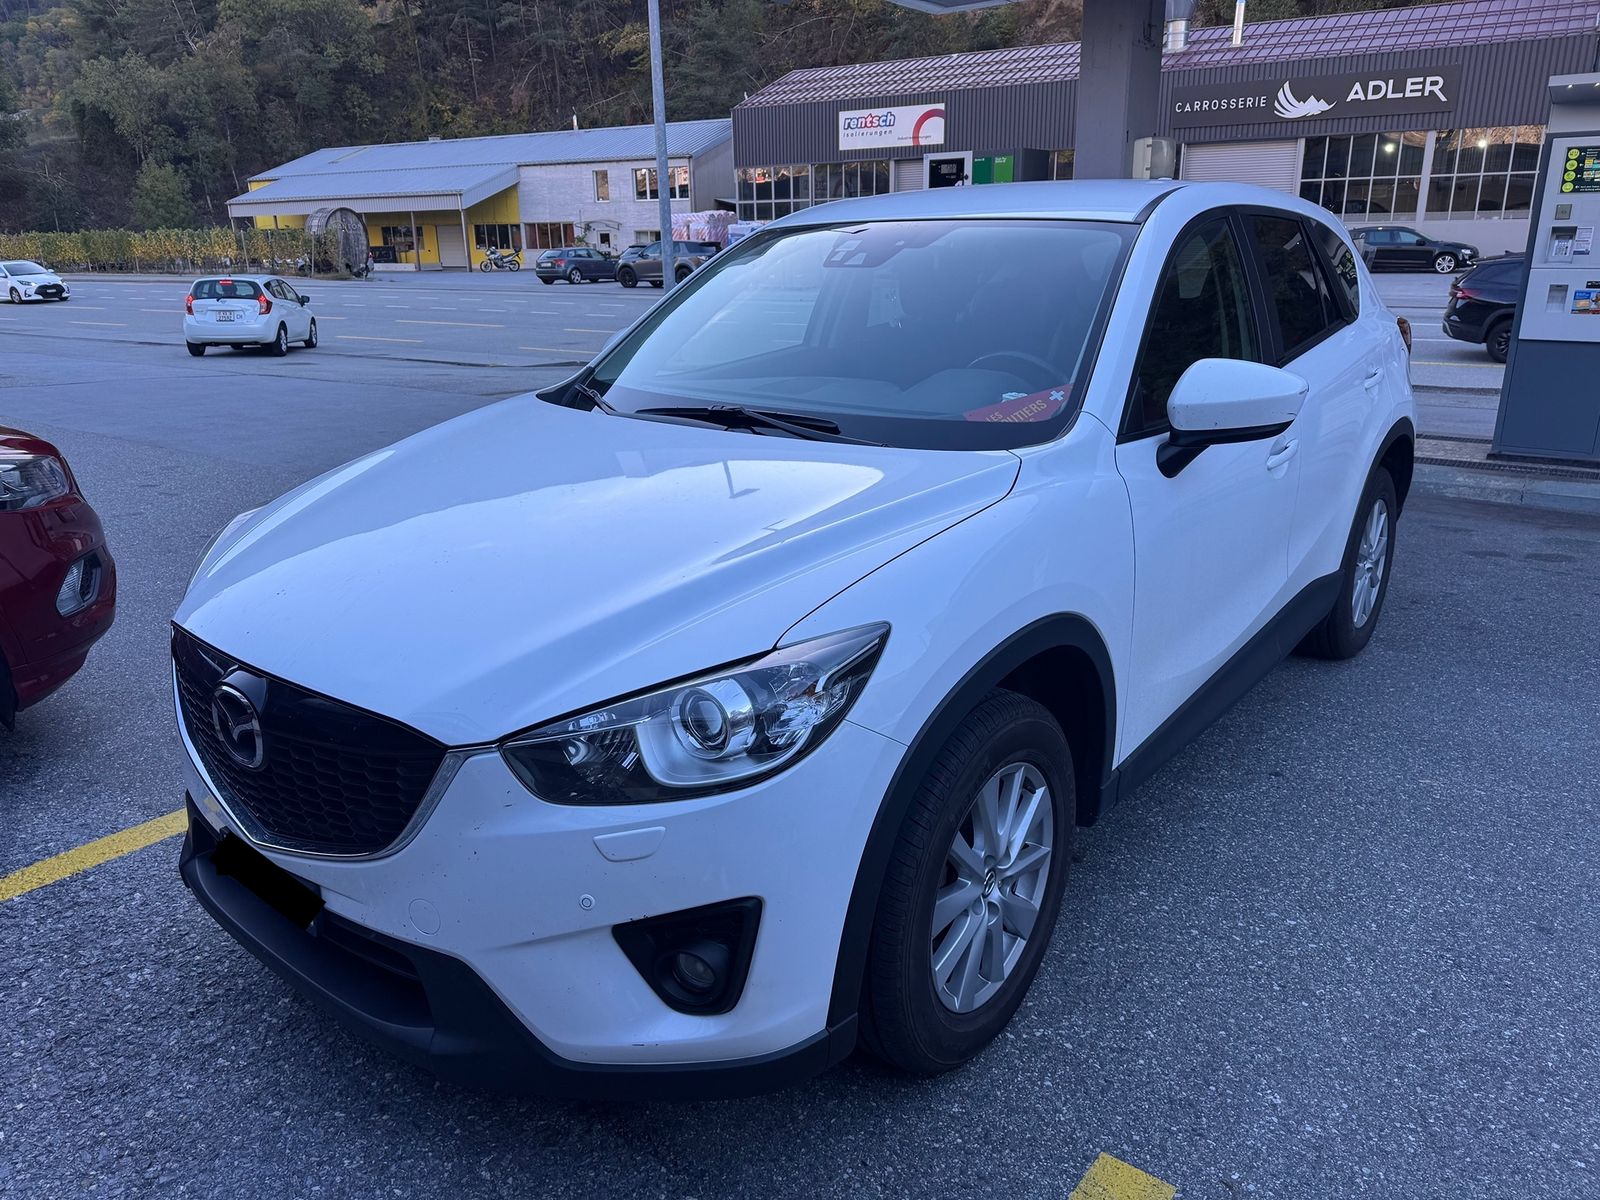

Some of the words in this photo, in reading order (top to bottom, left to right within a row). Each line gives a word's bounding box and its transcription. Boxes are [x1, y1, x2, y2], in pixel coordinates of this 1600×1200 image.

[1175, 95, 1267, 113] CARROSSERIE
[1345, 75, 1448, 102] ADLER
[843, 111, 896, 130] rentsch
